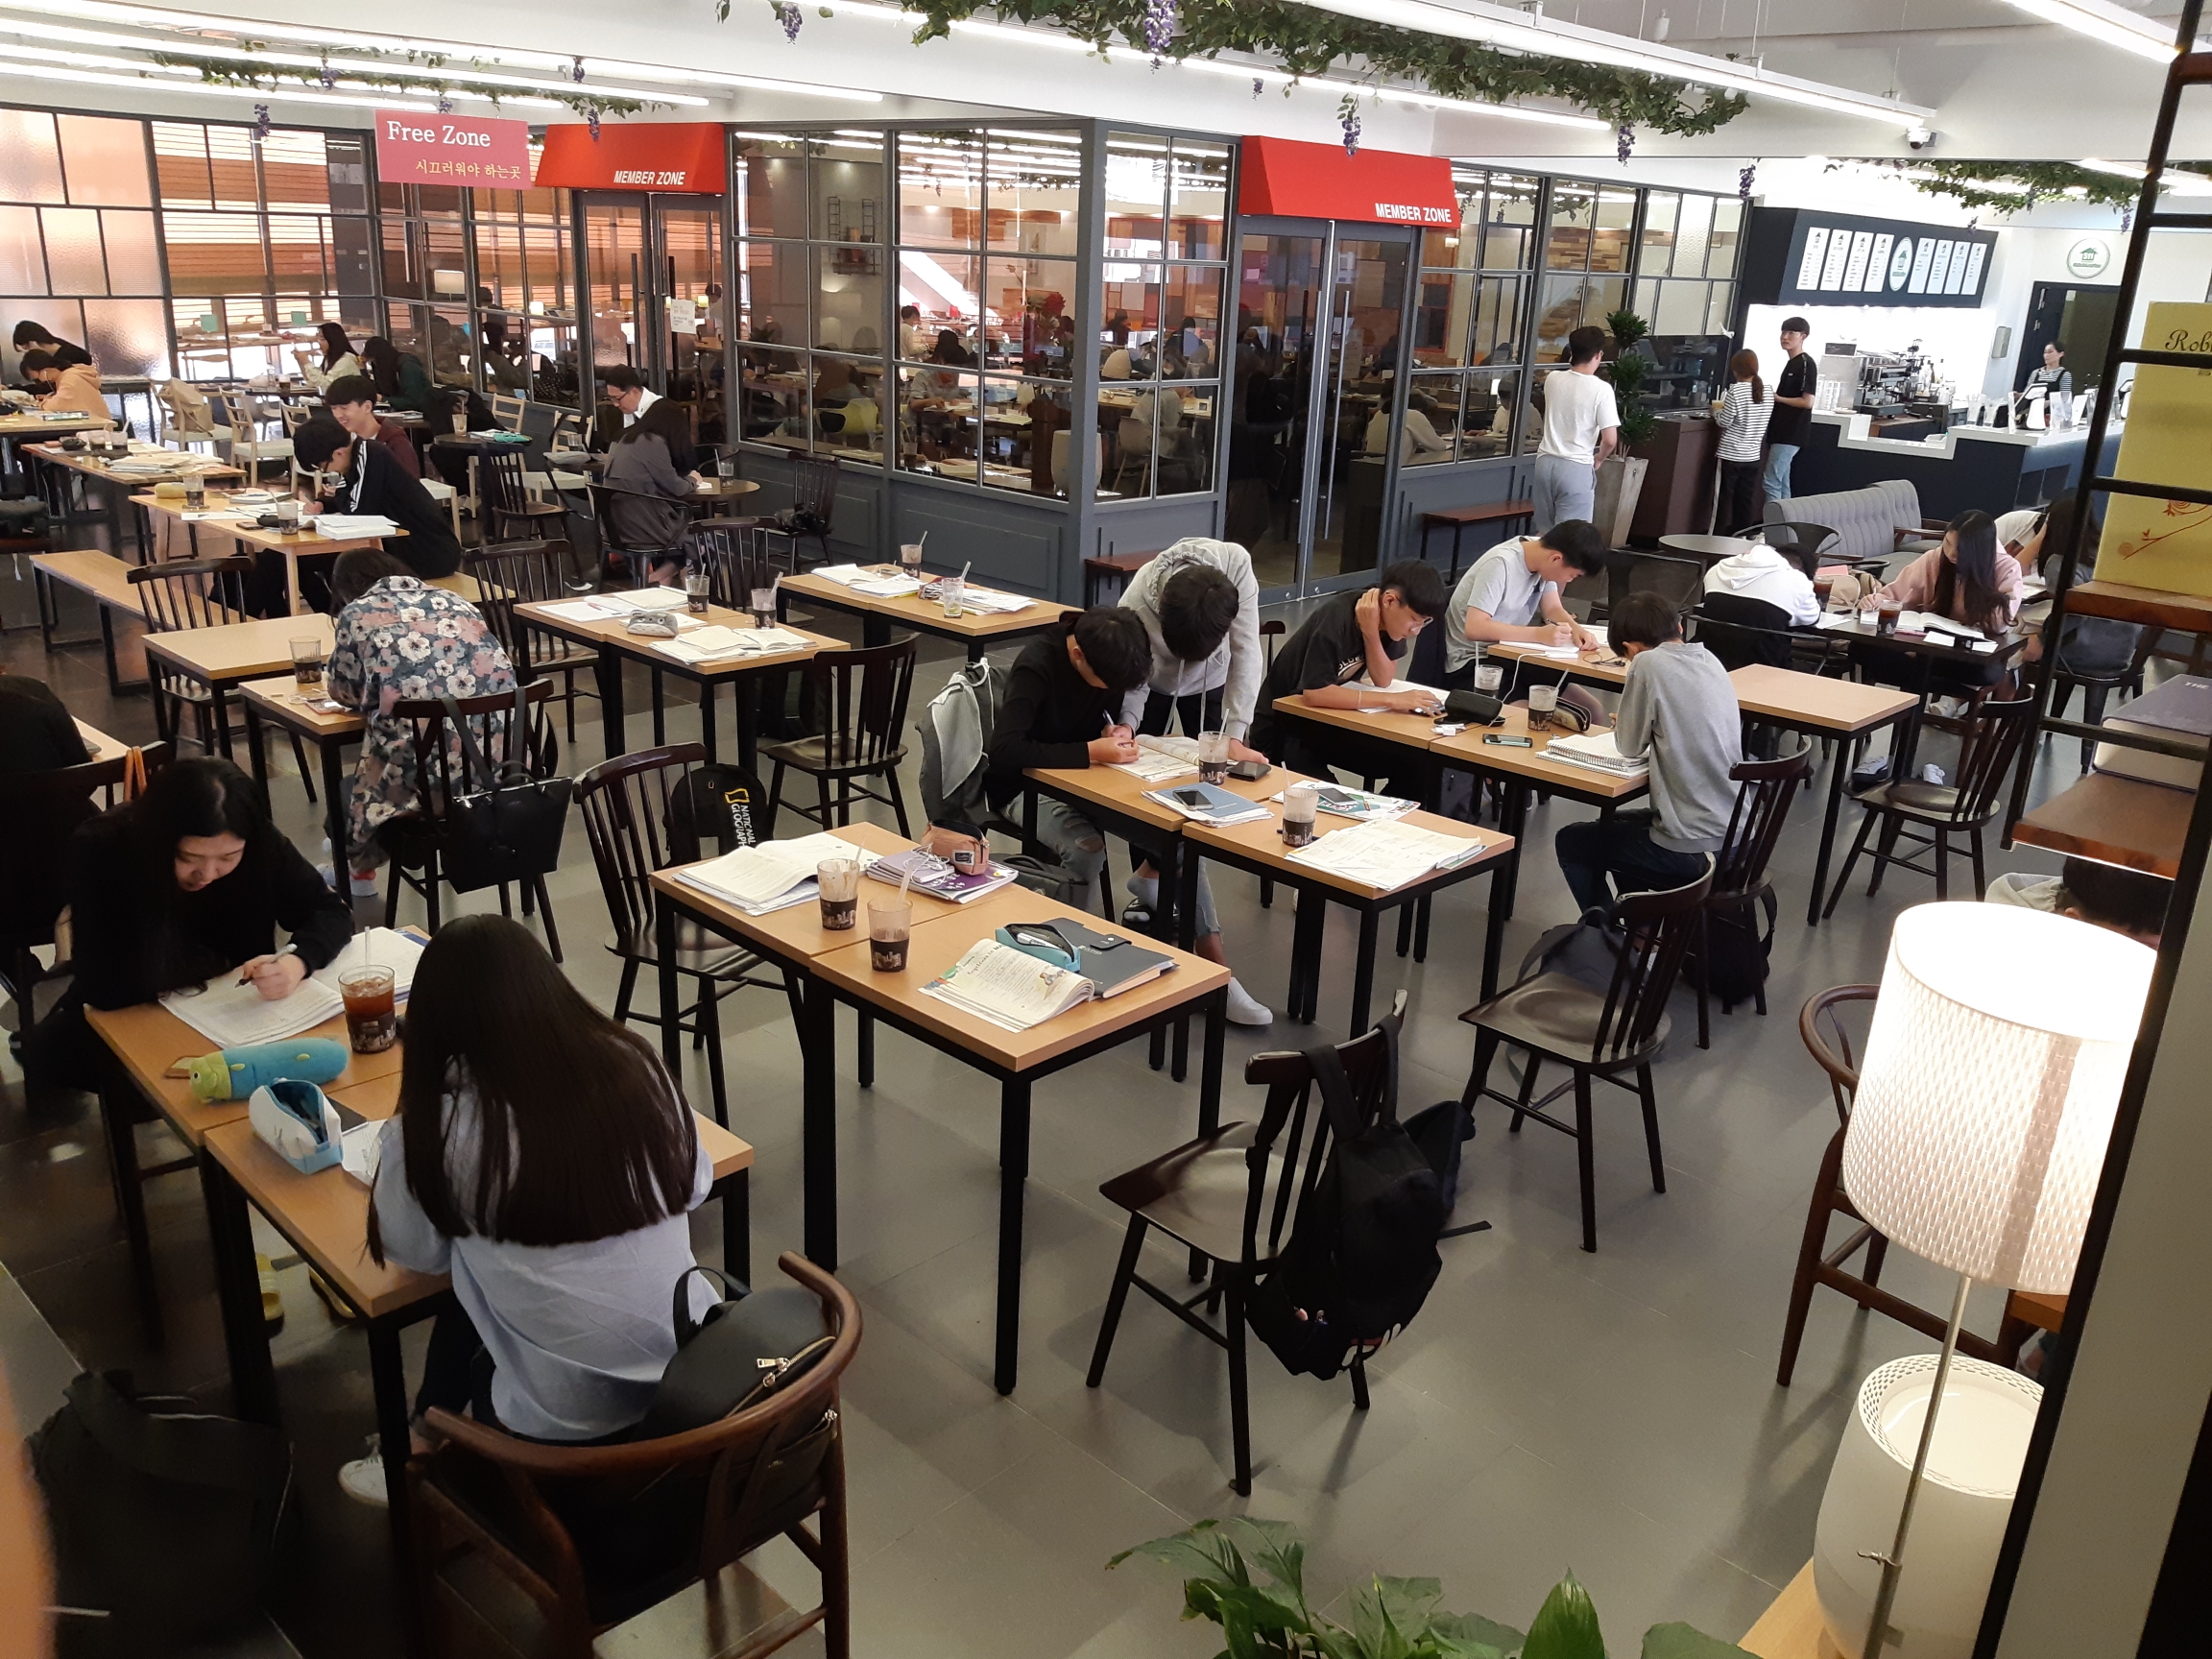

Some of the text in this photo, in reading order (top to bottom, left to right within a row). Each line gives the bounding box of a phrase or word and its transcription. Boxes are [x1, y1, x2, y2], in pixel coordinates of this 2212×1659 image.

[387, 120, 491, 147] Free Zone
[415, 158, 521, 180] 시끄러워야 하는곳
[613, 170, 685, 185] MEMBER ZONE
[1375, 203, 1452, 223] MEMBER ZONE
[2165, 329, 2212, 352] Rob
[731, 804, 748, 846] GEOGRAPH
[739, 805, 757, 844] NATIONAL
